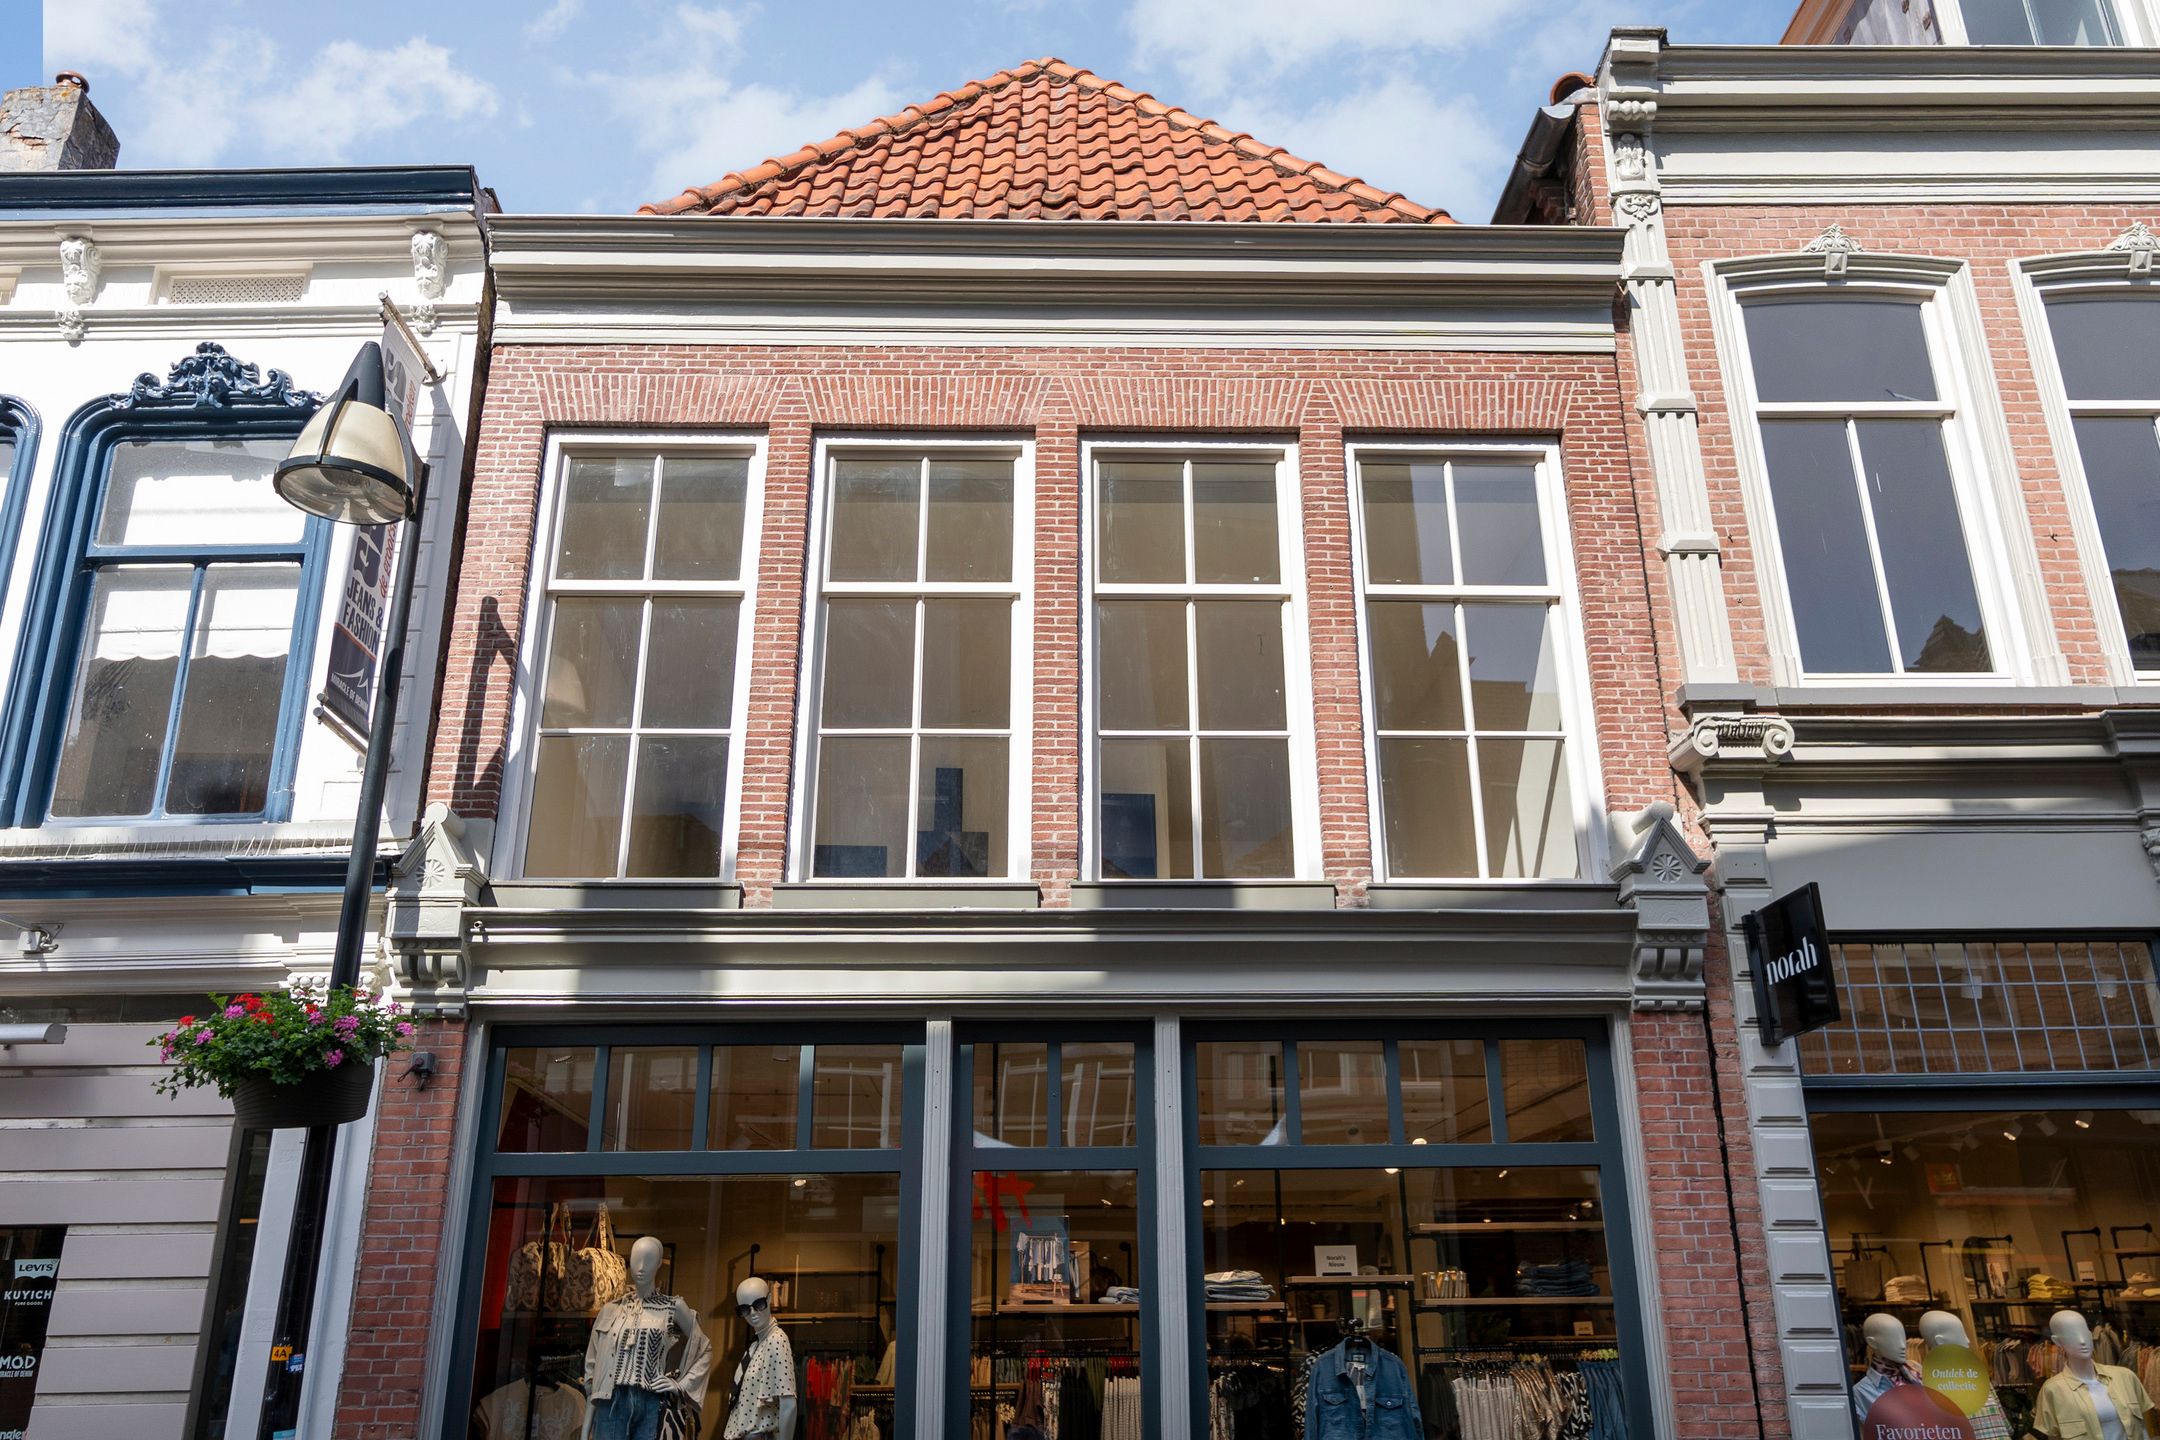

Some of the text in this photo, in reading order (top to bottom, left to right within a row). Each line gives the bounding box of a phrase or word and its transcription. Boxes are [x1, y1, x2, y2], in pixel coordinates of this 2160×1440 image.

[346, 576, 384, 630] JEANS &
[342, 601, 381, 655] FASHION
[1766, 936, 1818, 985] norah
[3, 1290, 53, 1300] KUYICH
[274, 1349, 288, 1358] 4A
[1932, 1368, 1978, 1378] Ontdek de
[1875, 1423, 1963, 1440] Favorieten
